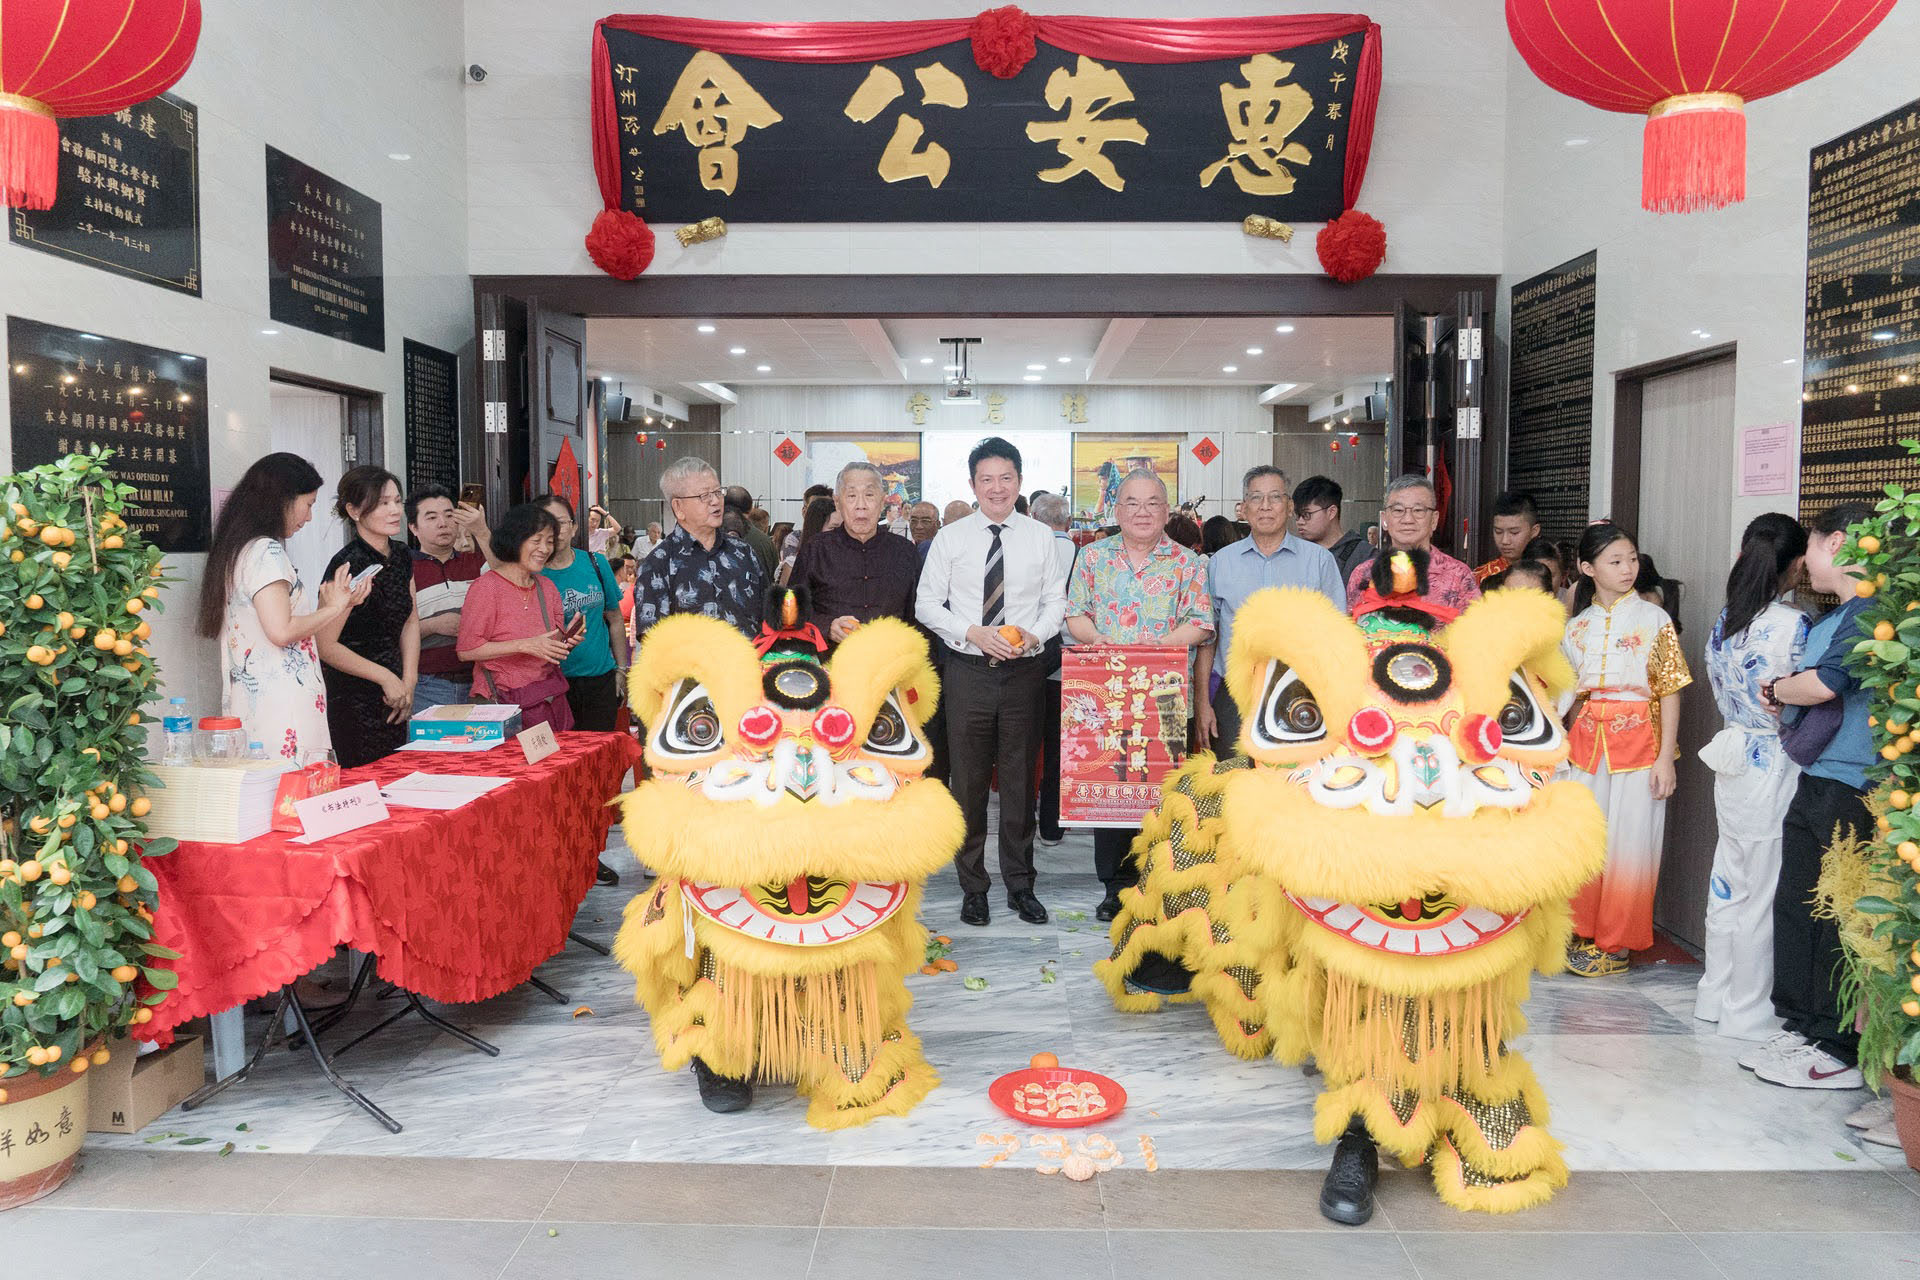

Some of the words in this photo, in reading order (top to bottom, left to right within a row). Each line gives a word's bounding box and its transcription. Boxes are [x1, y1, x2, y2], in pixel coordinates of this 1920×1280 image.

[653, 50, 1314, 196] 惠安公會
[1812, 112, 1920, 171] 新加坡惠安公會大廈
[121, 472, 135, 481] WAS
[136, 472, 160, 482] OPENED
[161, 474, 170, 483] BY
[1104, 655, 1127, 755] 心想事成
[1127, 665, 1151, 774] 福星高照
[111, 1111, 125, 1123] M
